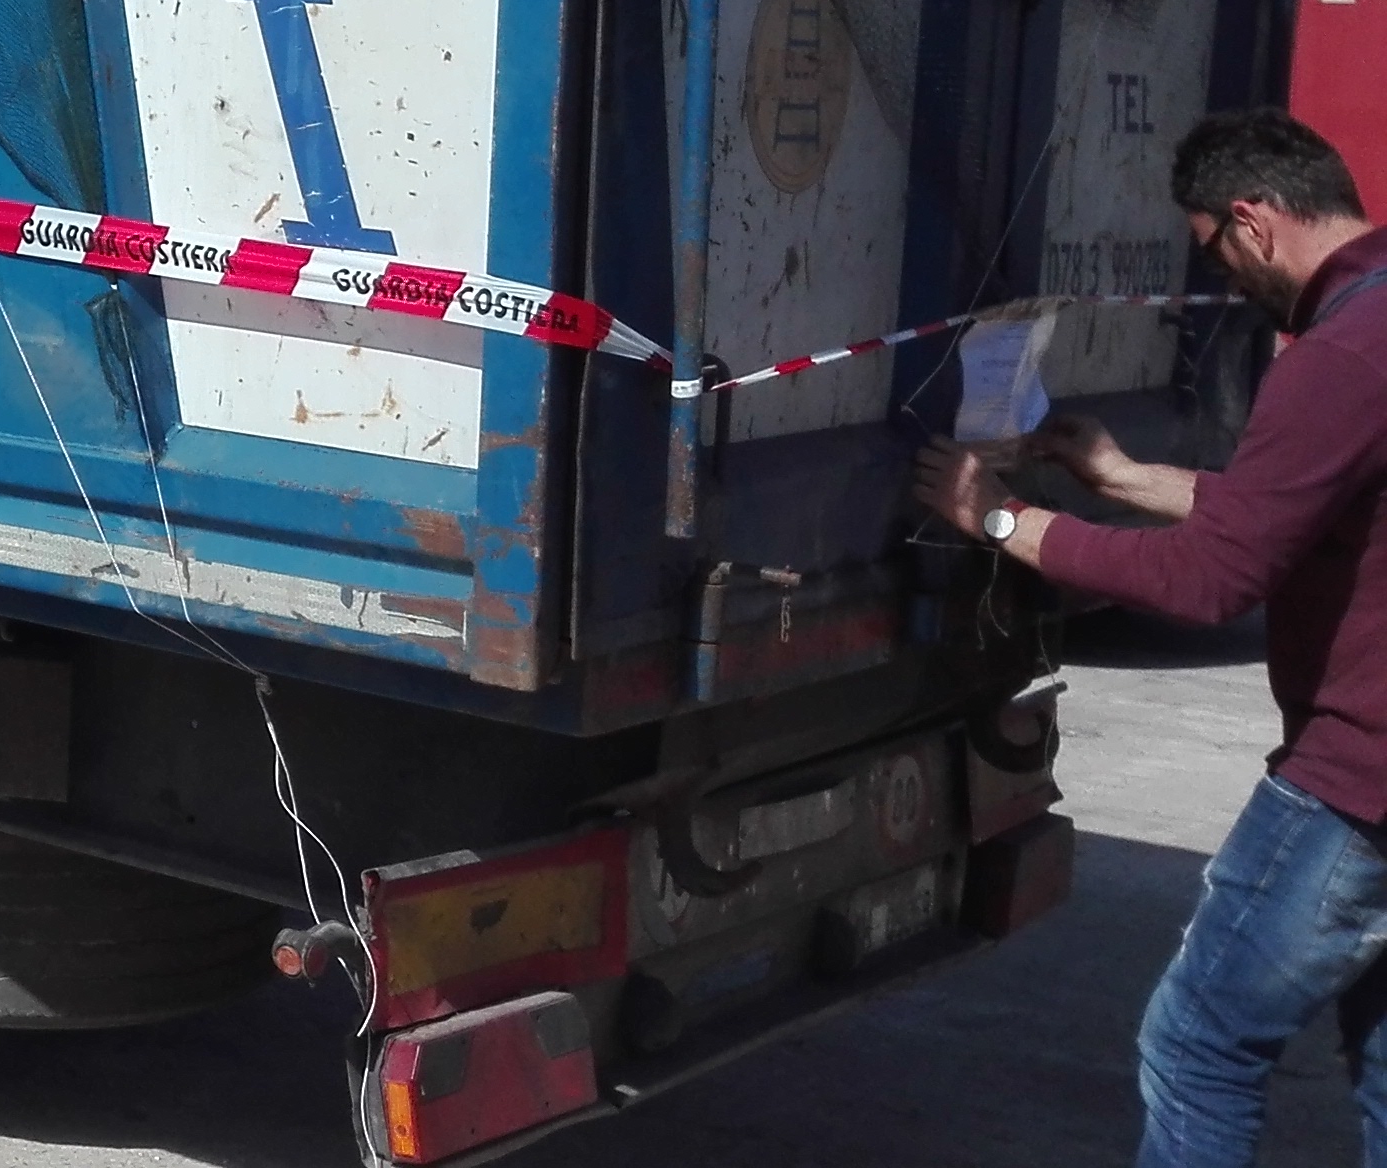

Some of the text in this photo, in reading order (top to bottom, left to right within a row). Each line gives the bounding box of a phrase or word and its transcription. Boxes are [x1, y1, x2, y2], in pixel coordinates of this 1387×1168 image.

[1107, 73, 1155, 133] TEL
[19, 217, 236, 275] GUARDIA COSTIERA
[331, 268, 582, 333] GUARDIA COSTIERA
